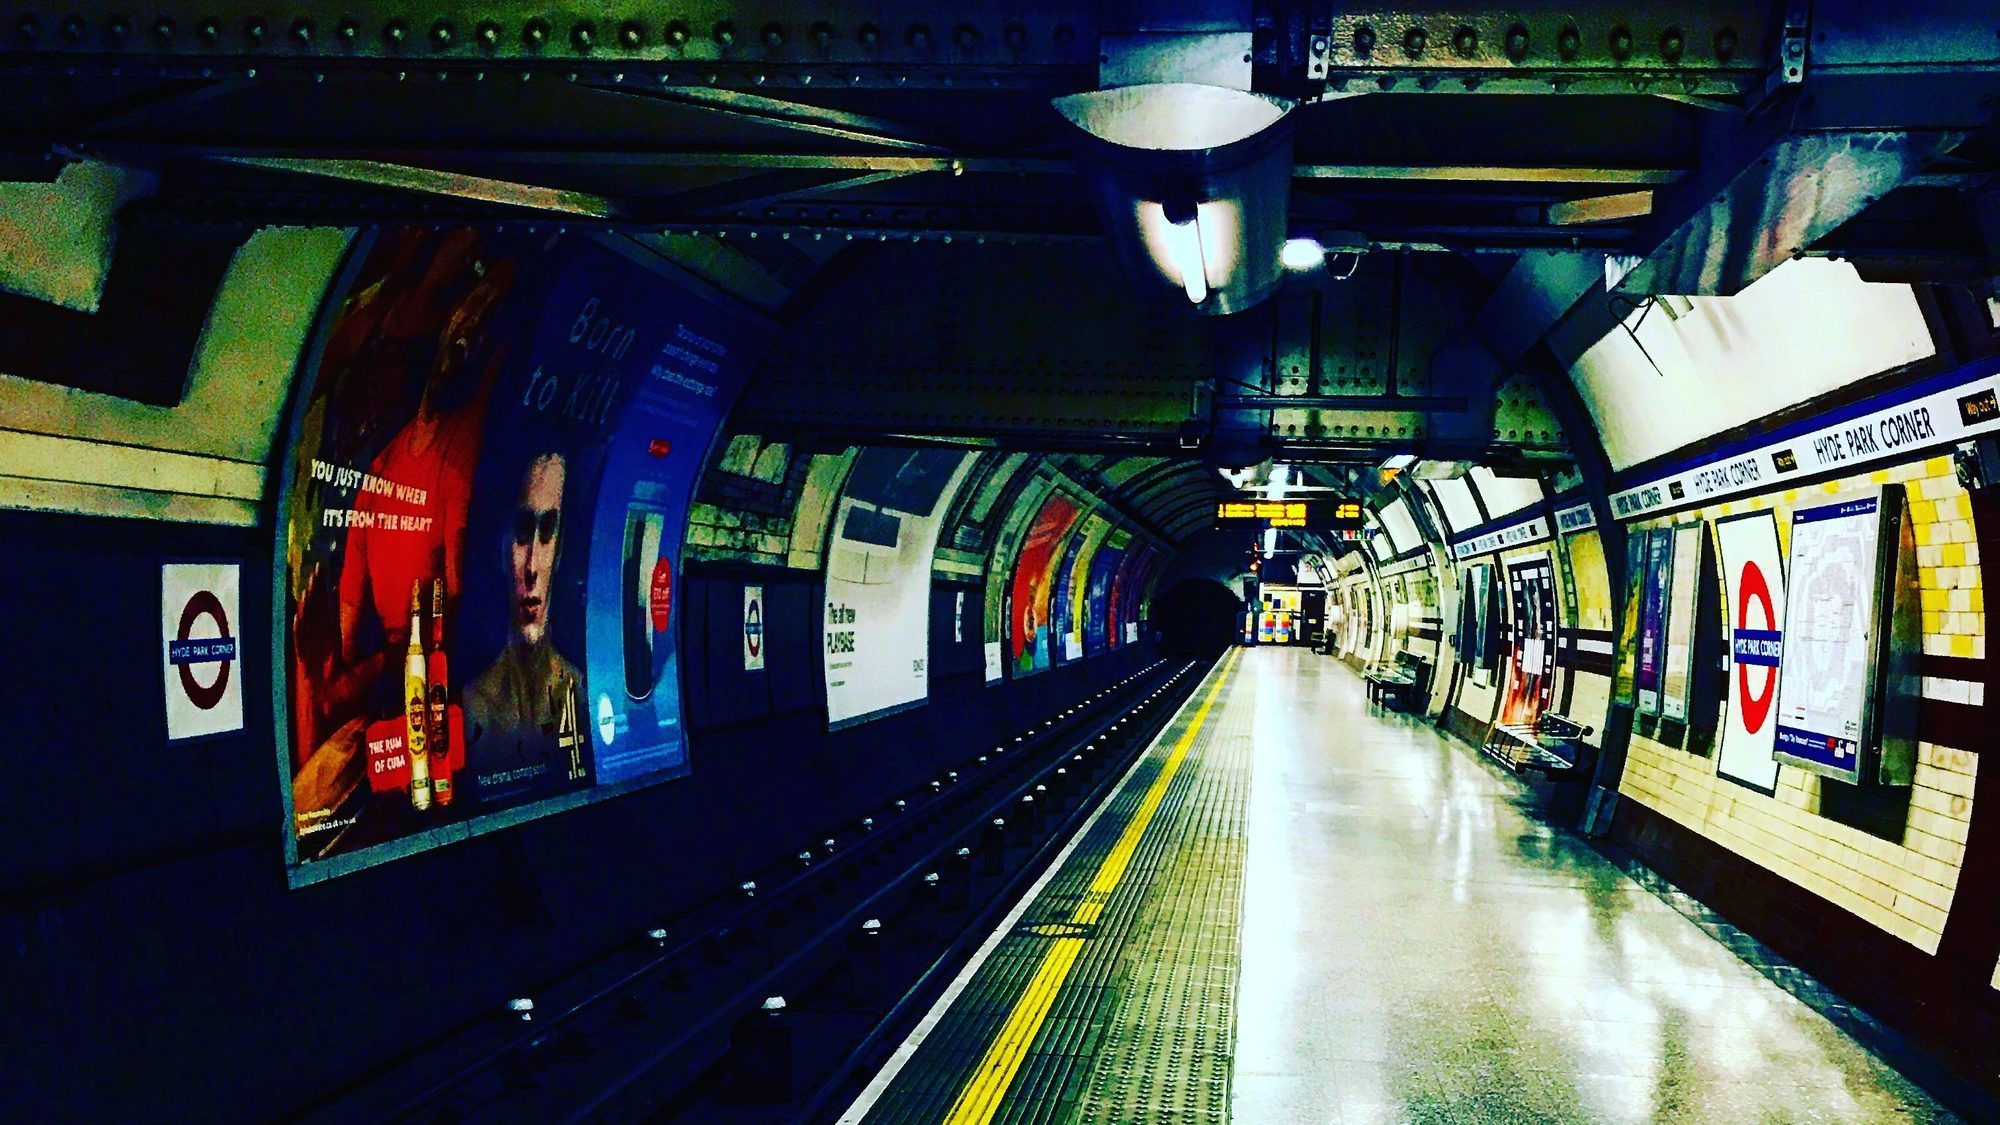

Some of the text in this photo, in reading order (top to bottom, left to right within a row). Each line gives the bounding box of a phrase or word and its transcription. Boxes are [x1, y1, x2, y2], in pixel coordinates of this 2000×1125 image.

[568, 296, 635, 361] Born
[523, 364, 558, 411] to
[562, 371, 620, 424] Kill
[1814, 407, 1936, 464] HYDE PARK CORNER
[311, 459, 428, 507] YOU JUST KNOW WHEN
[1694, 457, 1762, 495] HYDE PARK CORNER
[322, 508, 433, 533] IT'S FROM THE HEART
[171, 643, 234, 658] HYDE PARK CORNER
[1735, 638, 1781, 657] HYDE PARK CORNER
[368, 736, 403, 756] THE RUM
[374, 754, 406, 774] OF CUBA
